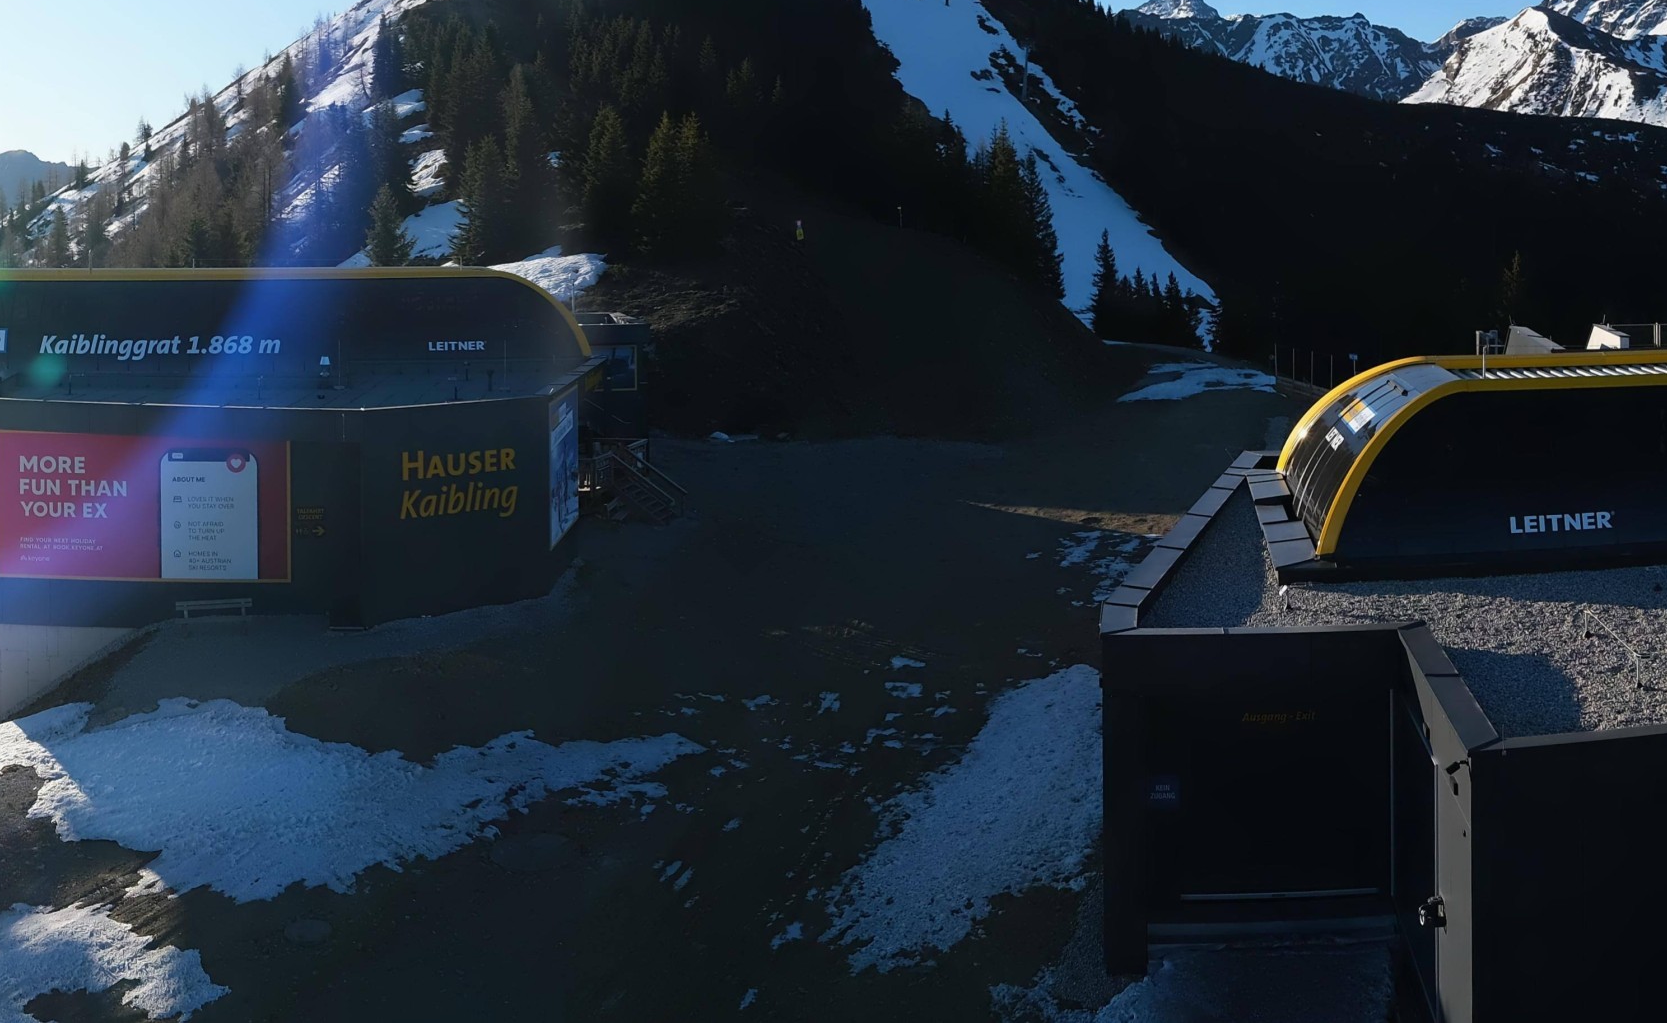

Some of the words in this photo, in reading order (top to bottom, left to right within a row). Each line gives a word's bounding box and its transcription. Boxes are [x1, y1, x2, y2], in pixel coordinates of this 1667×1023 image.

[39, 334, 181, 360] Kaiblinggrat
[186, 335, 252, 354] 1.868
[258, 338, 281, 354] m
[428, 340, 485, 352] LEITNER
[20, 456, 86, 474] MORE
[402, 448, 516, 481] HAUSER
[20, 478, 60, 496] FUN
[67, 480, 128, 497] THAN
[20, 501, 76, 517] YOUR
[82, 502, 108, 518] EX
[400, 481, 518, 520] Kaibling
[1509, 511, 1613, 534] LEITNER
[1241, 711, 1287, 725] Ausgang
